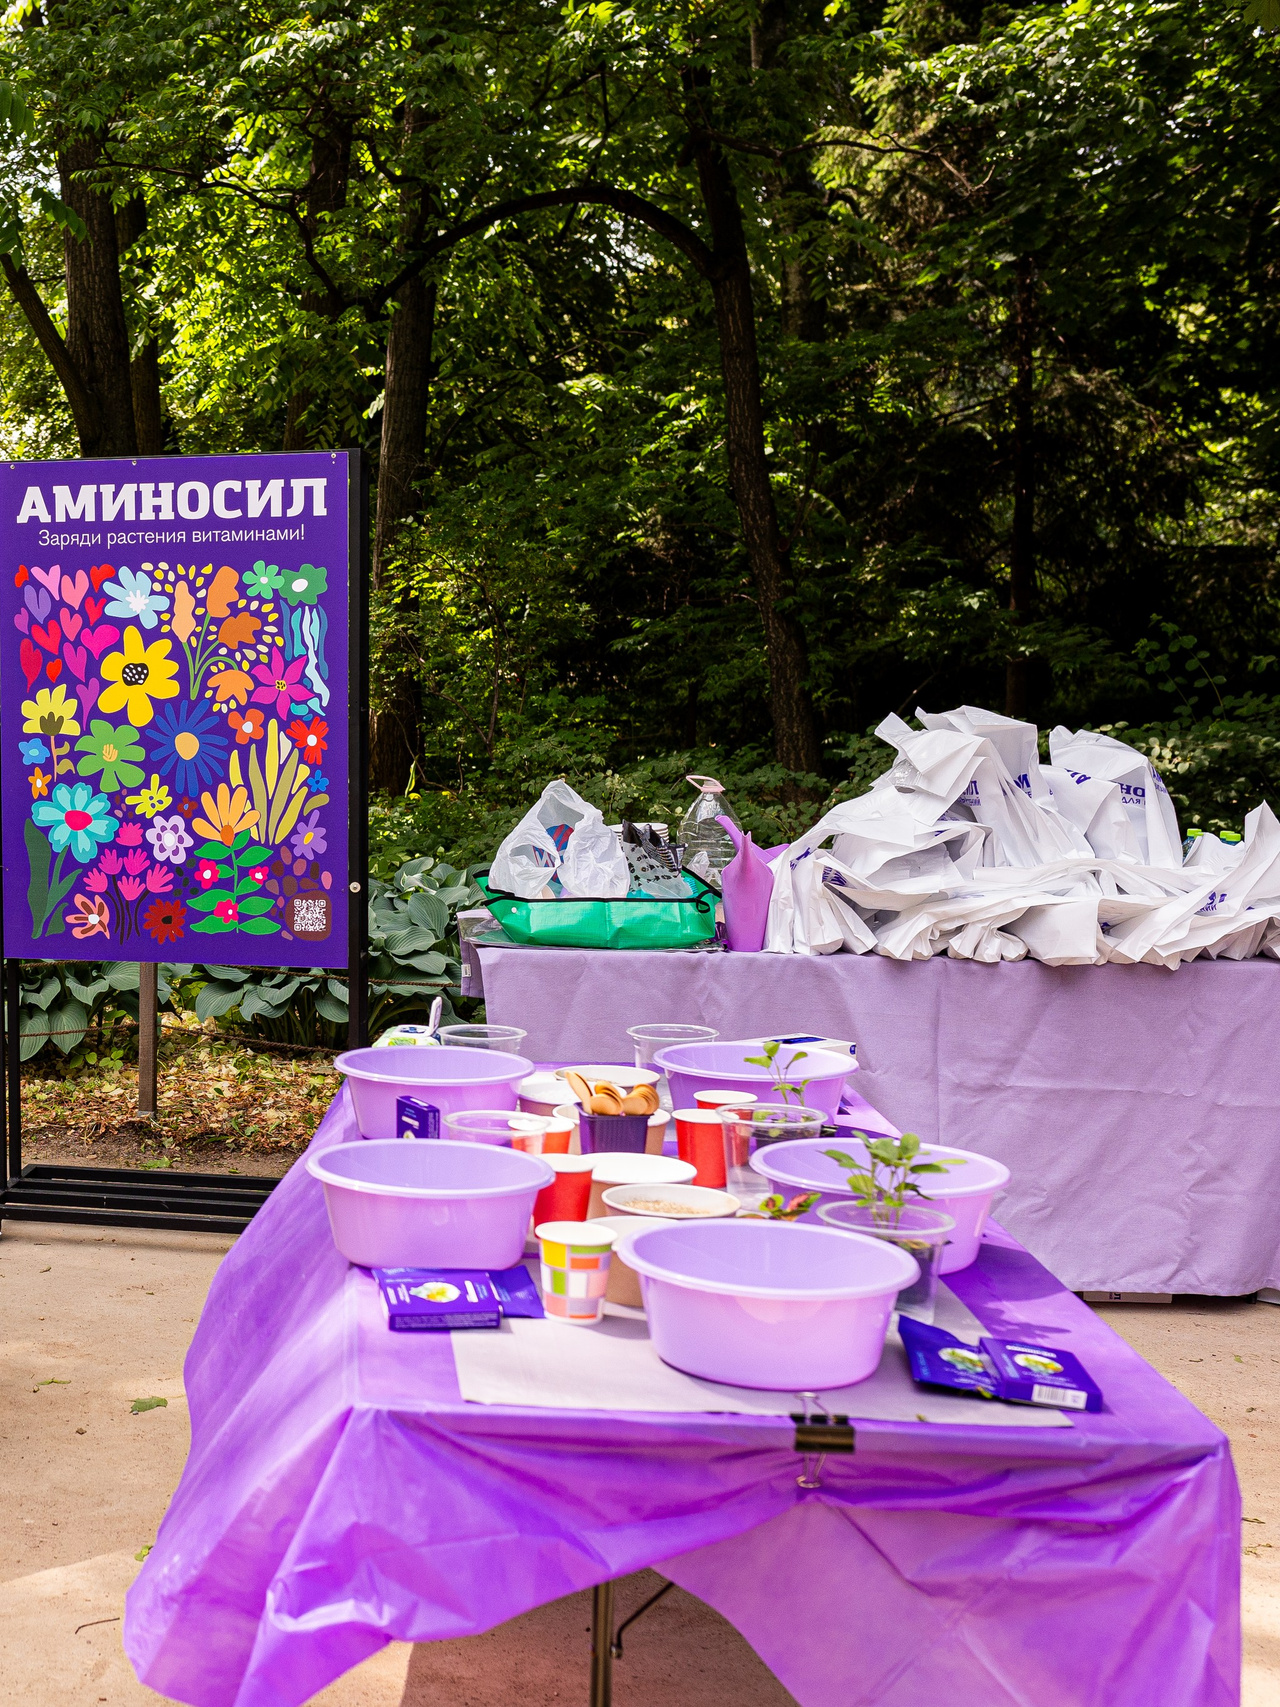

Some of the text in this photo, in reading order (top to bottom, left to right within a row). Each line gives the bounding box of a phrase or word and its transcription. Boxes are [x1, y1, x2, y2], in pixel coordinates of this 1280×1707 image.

[16, 477, 327, 524] АМИНОСИЛ
[38, 524, 305, 550] Заряди растения витаминами!
